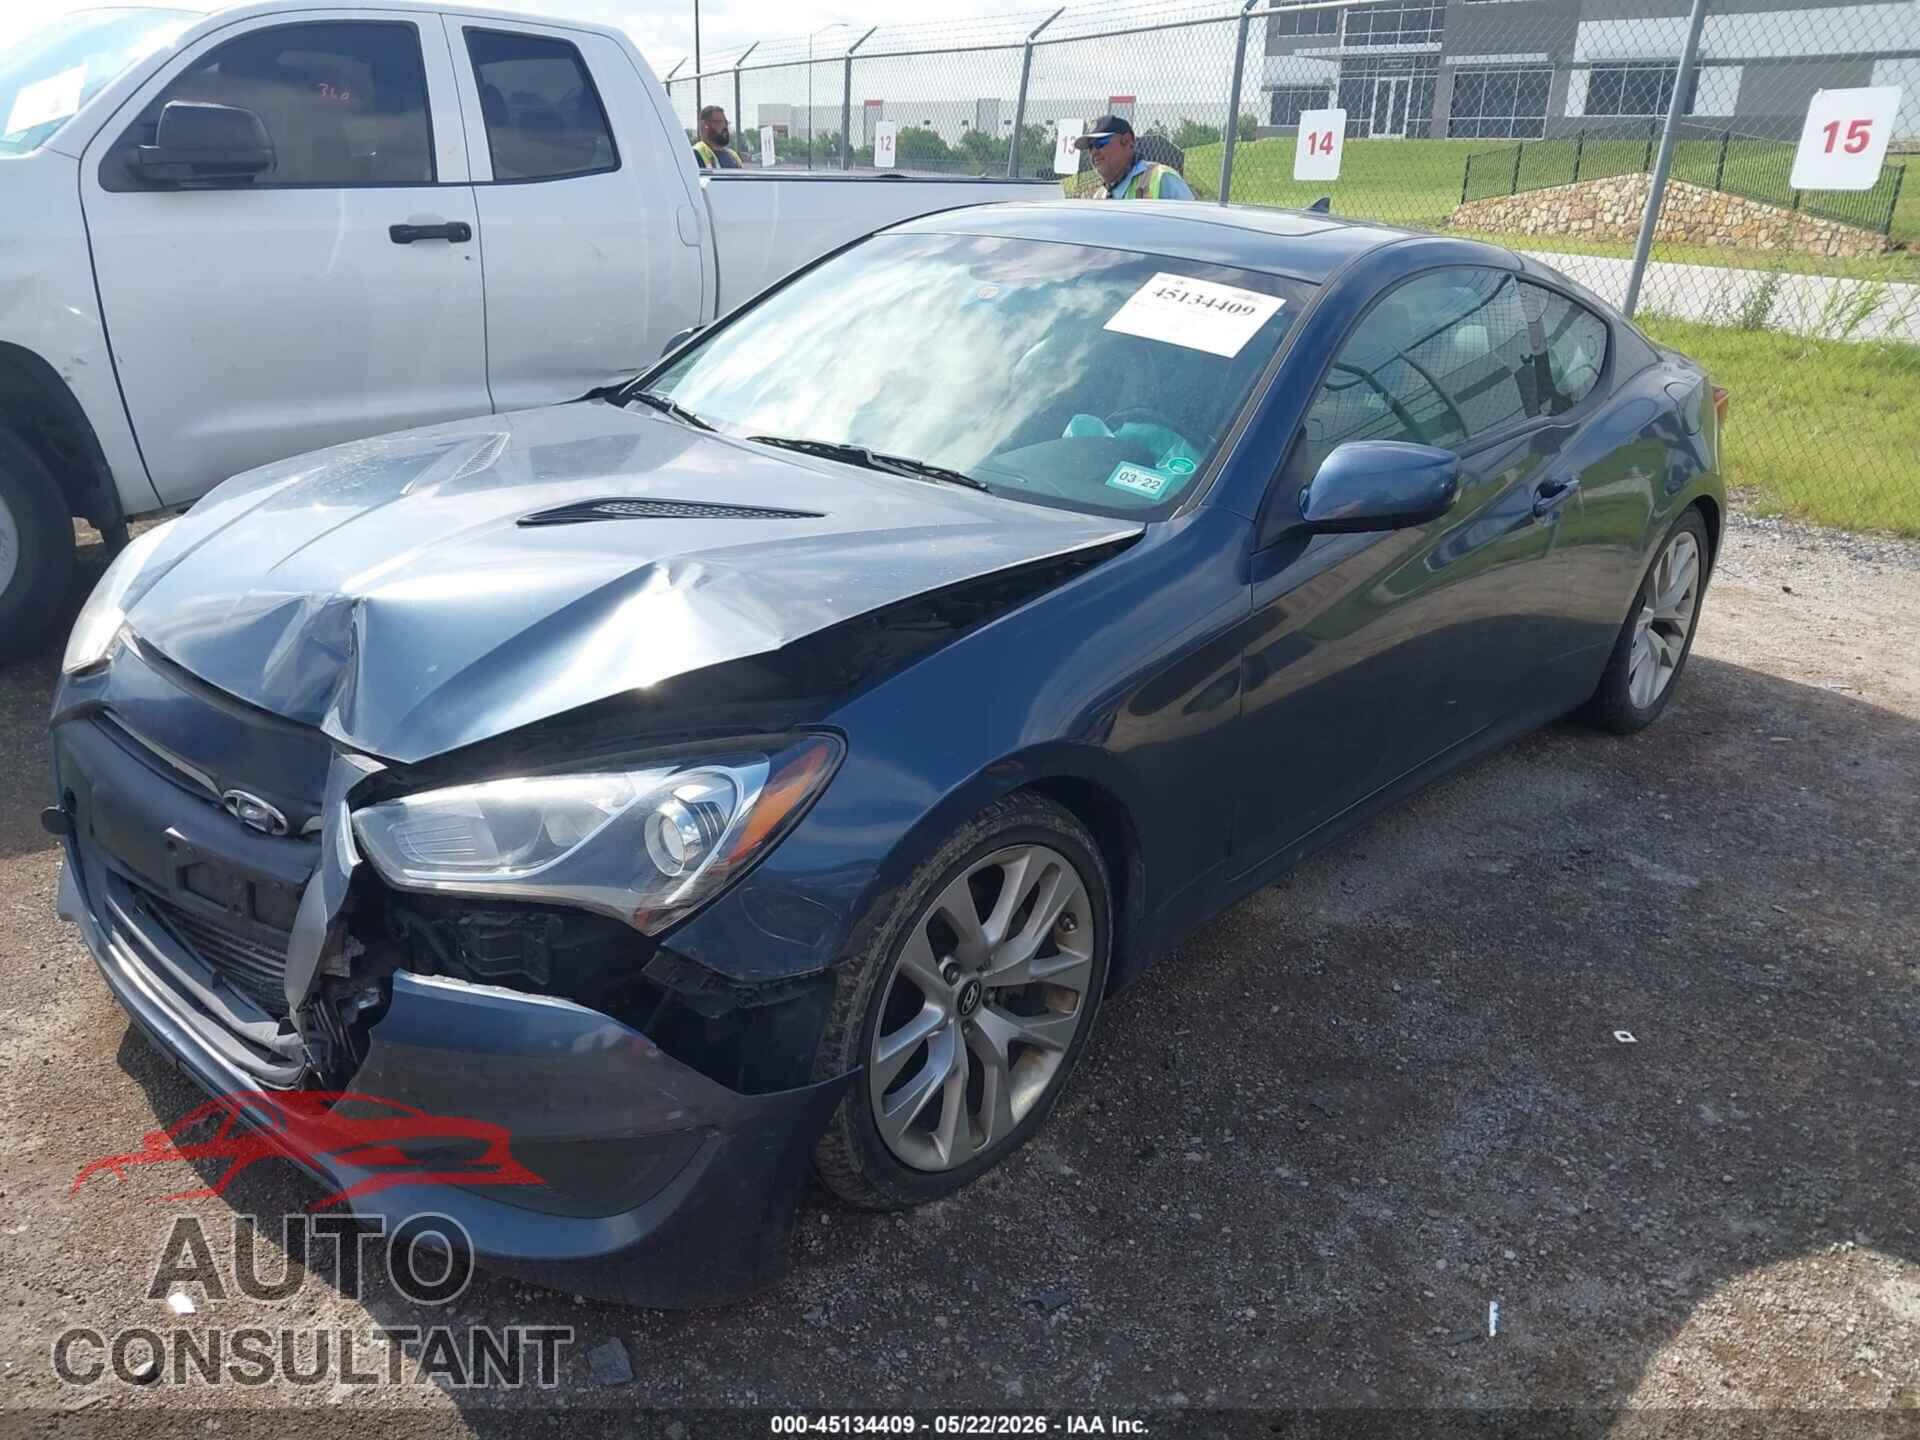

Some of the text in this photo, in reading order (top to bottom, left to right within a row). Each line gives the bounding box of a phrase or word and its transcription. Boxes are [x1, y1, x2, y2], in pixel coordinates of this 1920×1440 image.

[880, 135, 892, 151] 12
[1308, 131, 1334, 155] 14
[1823, 119, 1873, 154] 15
[1152, 287, 1256, 316] 45134409
